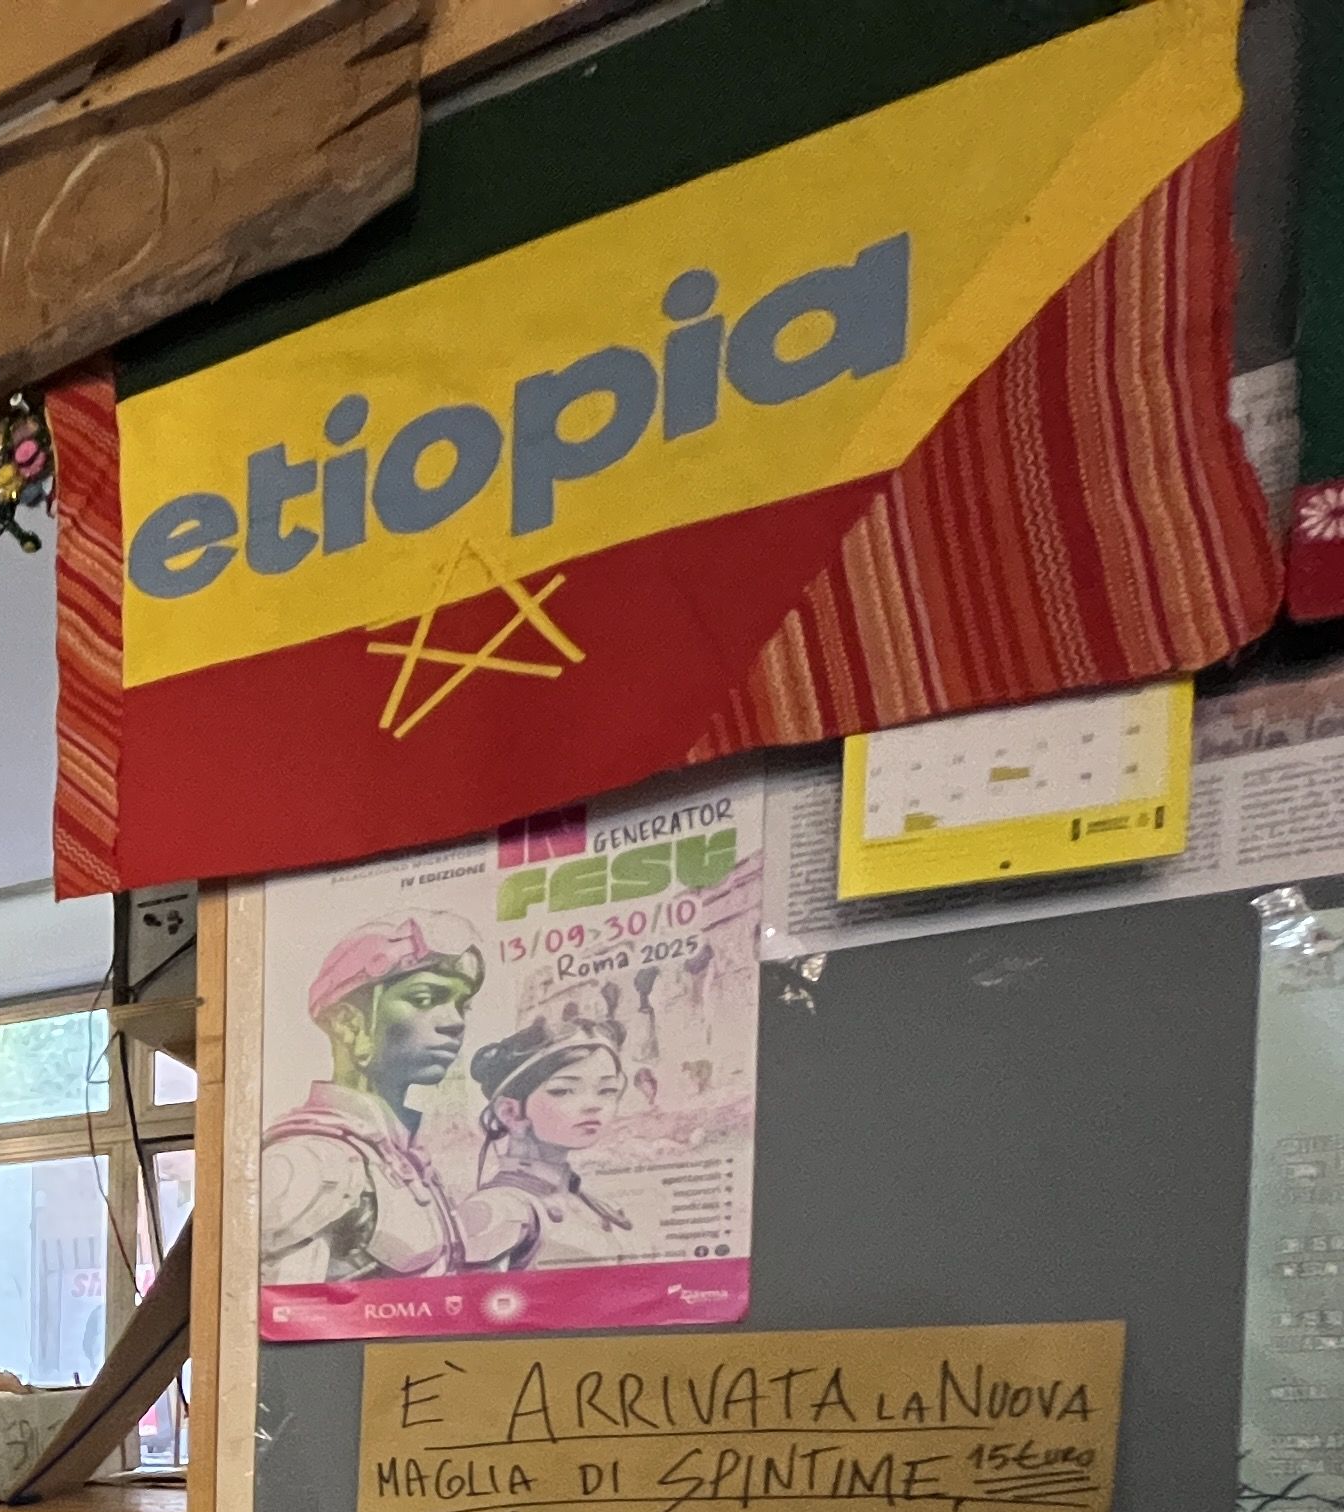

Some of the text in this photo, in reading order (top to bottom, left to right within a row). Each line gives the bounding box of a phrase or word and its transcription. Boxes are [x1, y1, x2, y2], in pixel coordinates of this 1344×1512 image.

[125, 230, 910, 600] etiopia
[593, 797, 734, 853] GENERATOR
[418, 862, 487, 886] EDIZIONE
[557, 935, 699, 980] Roma 2025
[364, 1302, 433, 1319] ROMA
[507, 1360, 856, 1444] ARRIVATA
[876, 1391, 933, 1423] LA
[940, 1360, 1102, 1423] NUOVA
[377, 1456, 537, 1500] MAGLIA
[579, 1460, 620, 1496] DI
